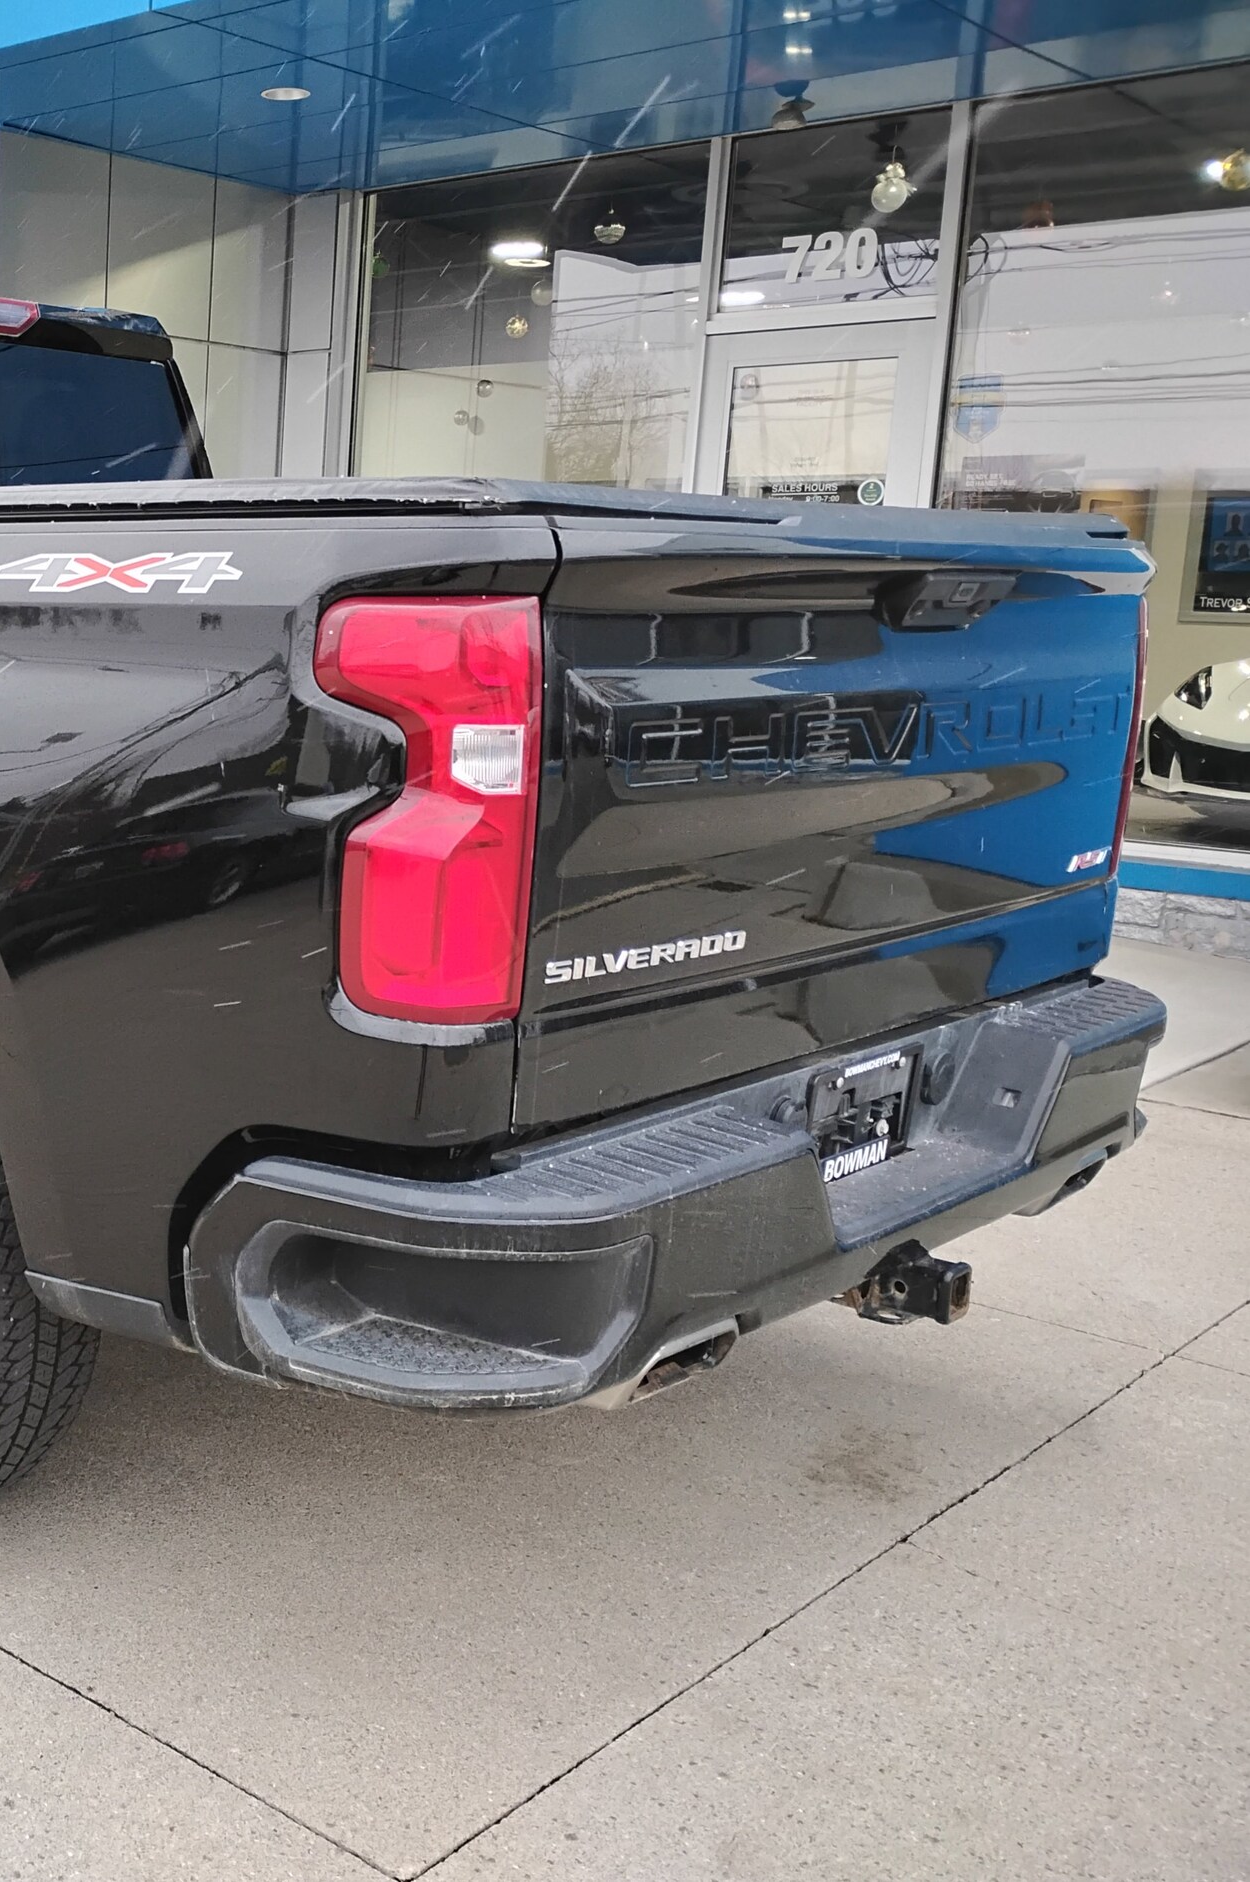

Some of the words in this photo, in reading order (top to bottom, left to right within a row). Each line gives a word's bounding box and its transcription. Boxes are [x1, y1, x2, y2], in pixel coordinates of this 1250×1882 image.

[782, 228, 877, 283] 720
[772, 483, 802, 493] SALES
[804, 482, 838, 492] HOURS
[627, 685, 1130, 789] CHEVROLET
[544, 930, 747, 985] SILVERADO
[823, 1138, 888, 1183] BOWMAN
